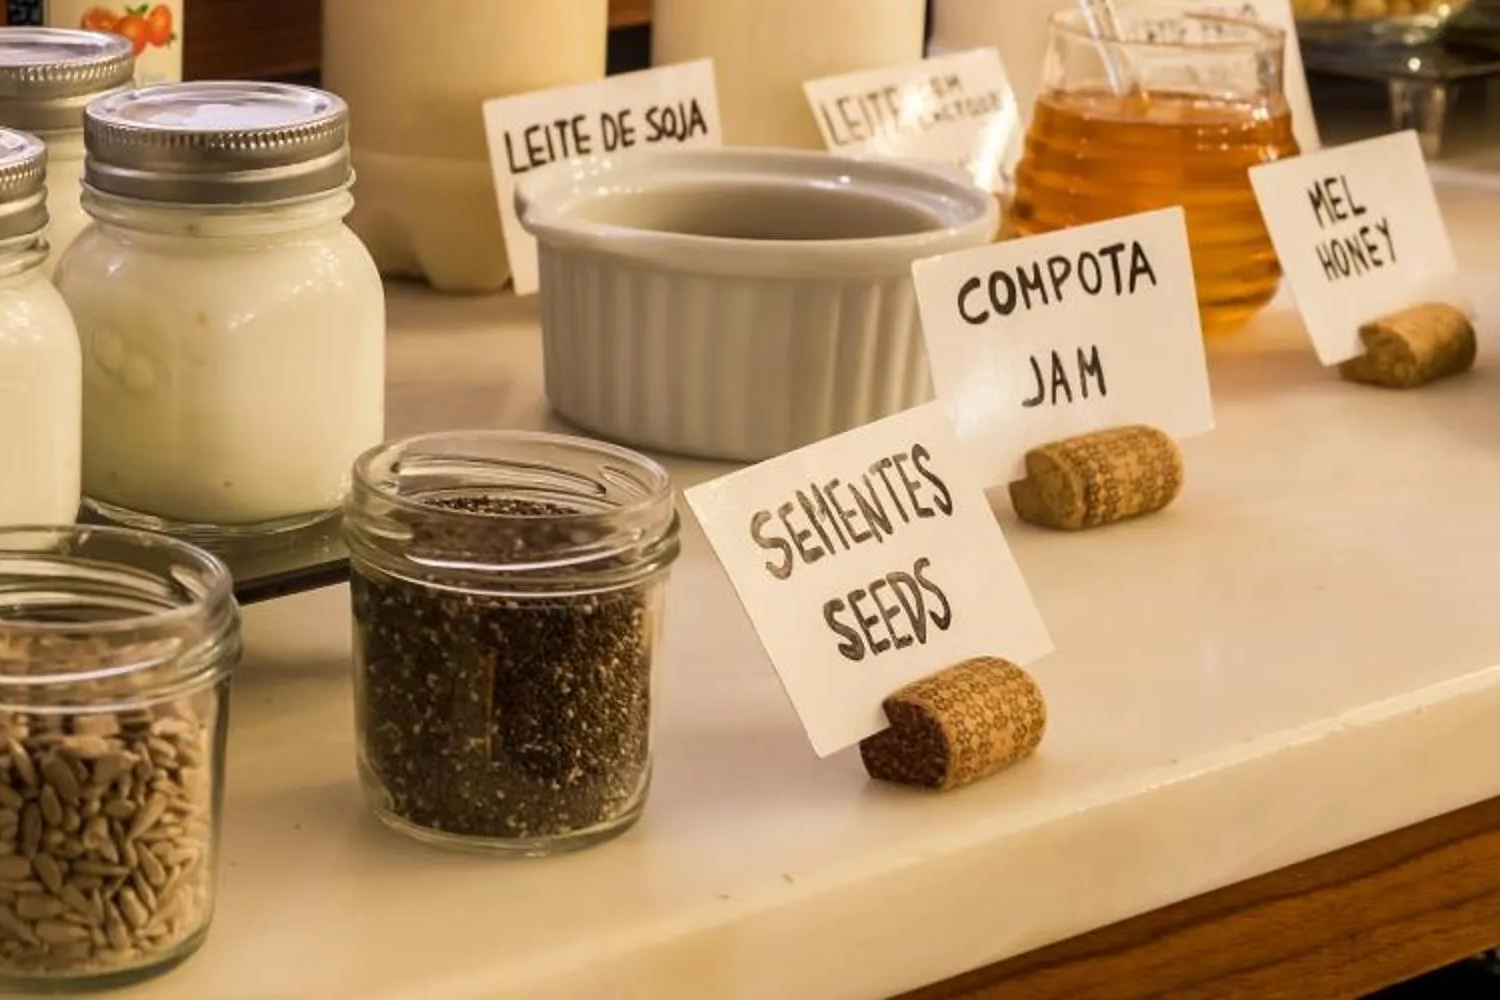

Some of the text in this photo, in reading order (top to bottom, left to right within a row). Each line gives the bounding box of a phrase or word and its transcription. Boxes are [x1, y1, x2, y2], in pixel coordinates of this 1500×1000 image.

[504, 97, 708, 175] LEITE DE SOJA
[1307, 173, 1368, 230] MEL
[956, 240, 1158, 325] COMPOTA
[1315, 217, 1397, 283] HONEY
[1021, 344, 1107, 408] JAM
[749, 441, 954, 581] SEMENTES
[822, 556, 952, 662] SEEDS
